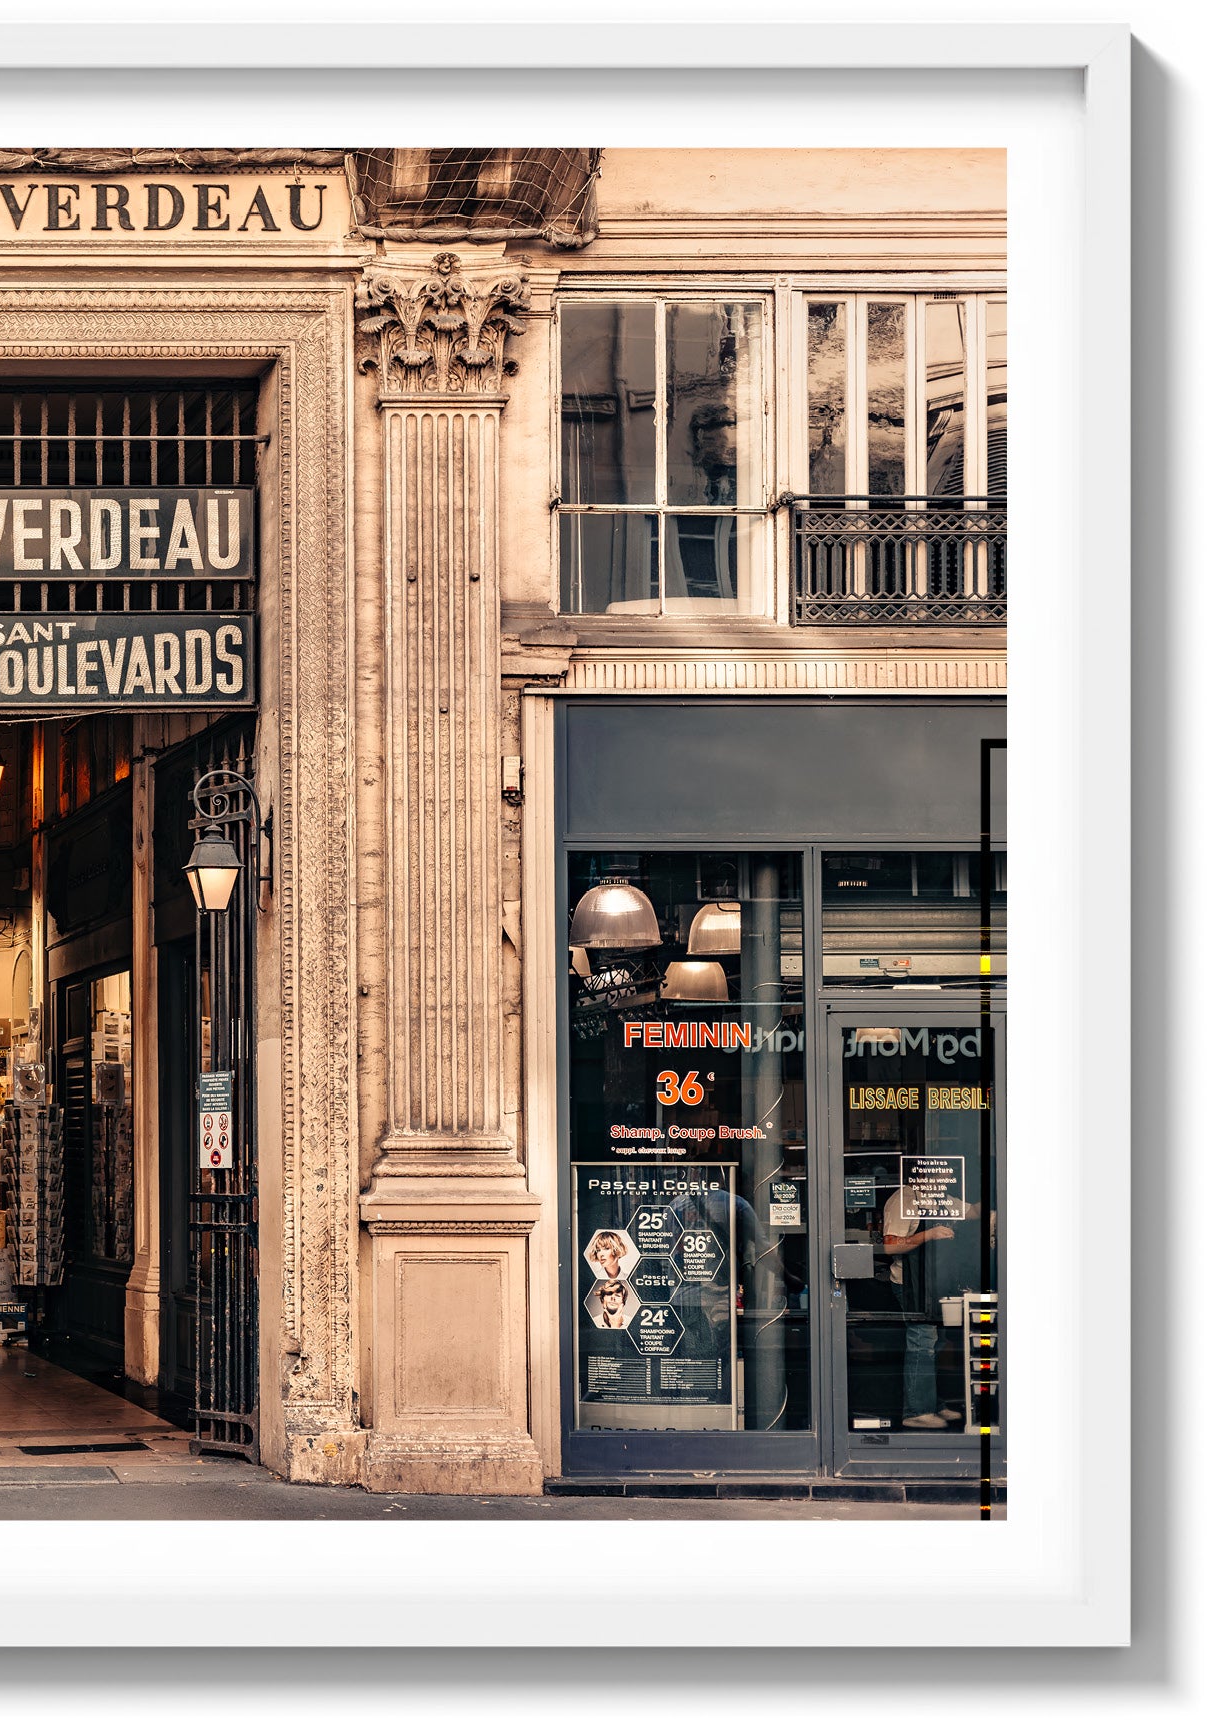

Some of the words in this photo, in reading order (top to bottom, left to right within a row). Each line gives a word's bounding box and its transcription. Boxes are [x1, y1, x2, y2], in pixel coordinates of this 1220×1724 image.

[624, 1021, 752, 1048] FEMININ
[849, 1087, 920, 1110] LISSAGE
[610, 1125, 665, 1141] Shamp.
[669, 1125, 716, 1141] Coupe
[588, 1180, 656, 1191] Pascal
[664, 1180, 720, 1191] Coste
[638, 1212, 668, 1230] 25€
[683, 1235, 712, 1253] 36€
[635, 1278, 676, 1287] Coste
[640, 1309, 669, 1327] 24€
